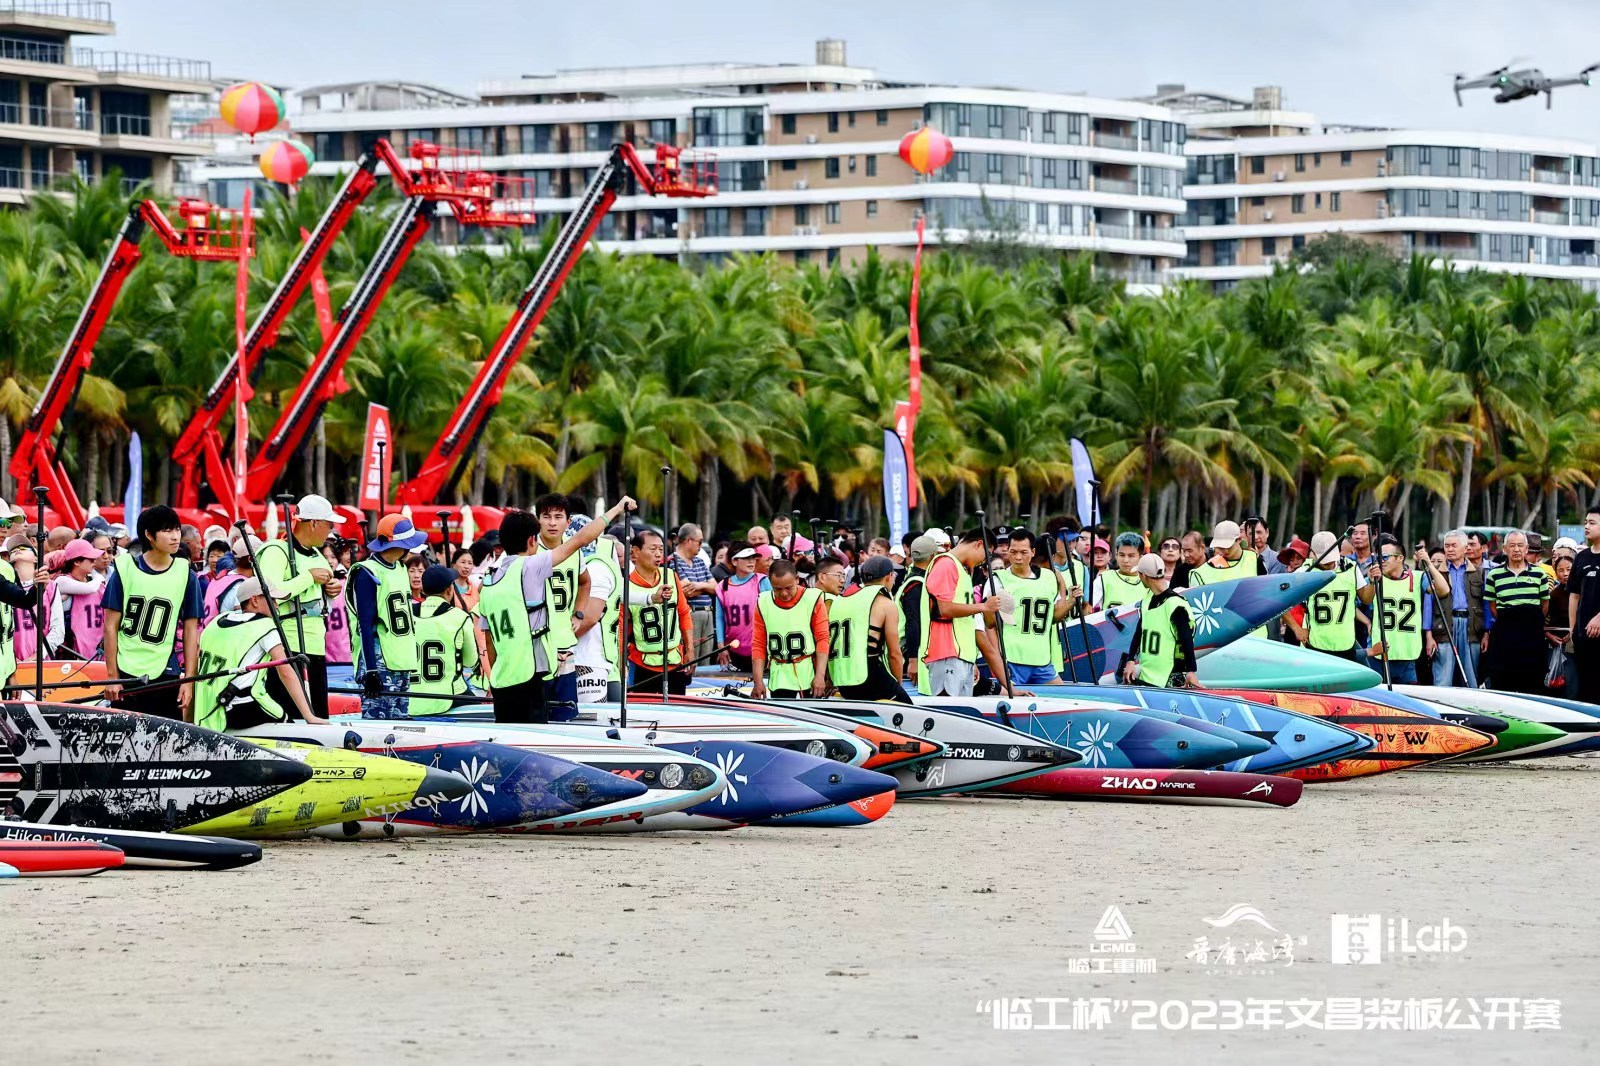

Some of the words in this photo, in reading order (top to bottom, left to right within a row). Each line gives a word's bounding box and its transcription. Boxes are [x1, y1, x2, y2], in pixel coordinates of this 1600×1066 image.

[119, 594, 174, 646] 90
[489, 607, 515, 642] 14
[640, 602, 677, 644] 87
[1020, 597, 1052, 636] 19
[1313, 590, 1351, 626] 67
[1380, 597, 1417, 633] 62
[828, 617, 851, 662] 21
[1140, 628, 1162, 656] 10
[410, 639, 446, 683] 6
[147, 768, 183, 780] WATER
[1101, 776, 1157, 790] ZHAO
[1159, 781, 1196, 789] MARINE
[364, 791, 449, 818] AZTRON
[6, 828, 103, 843] HikenWt
